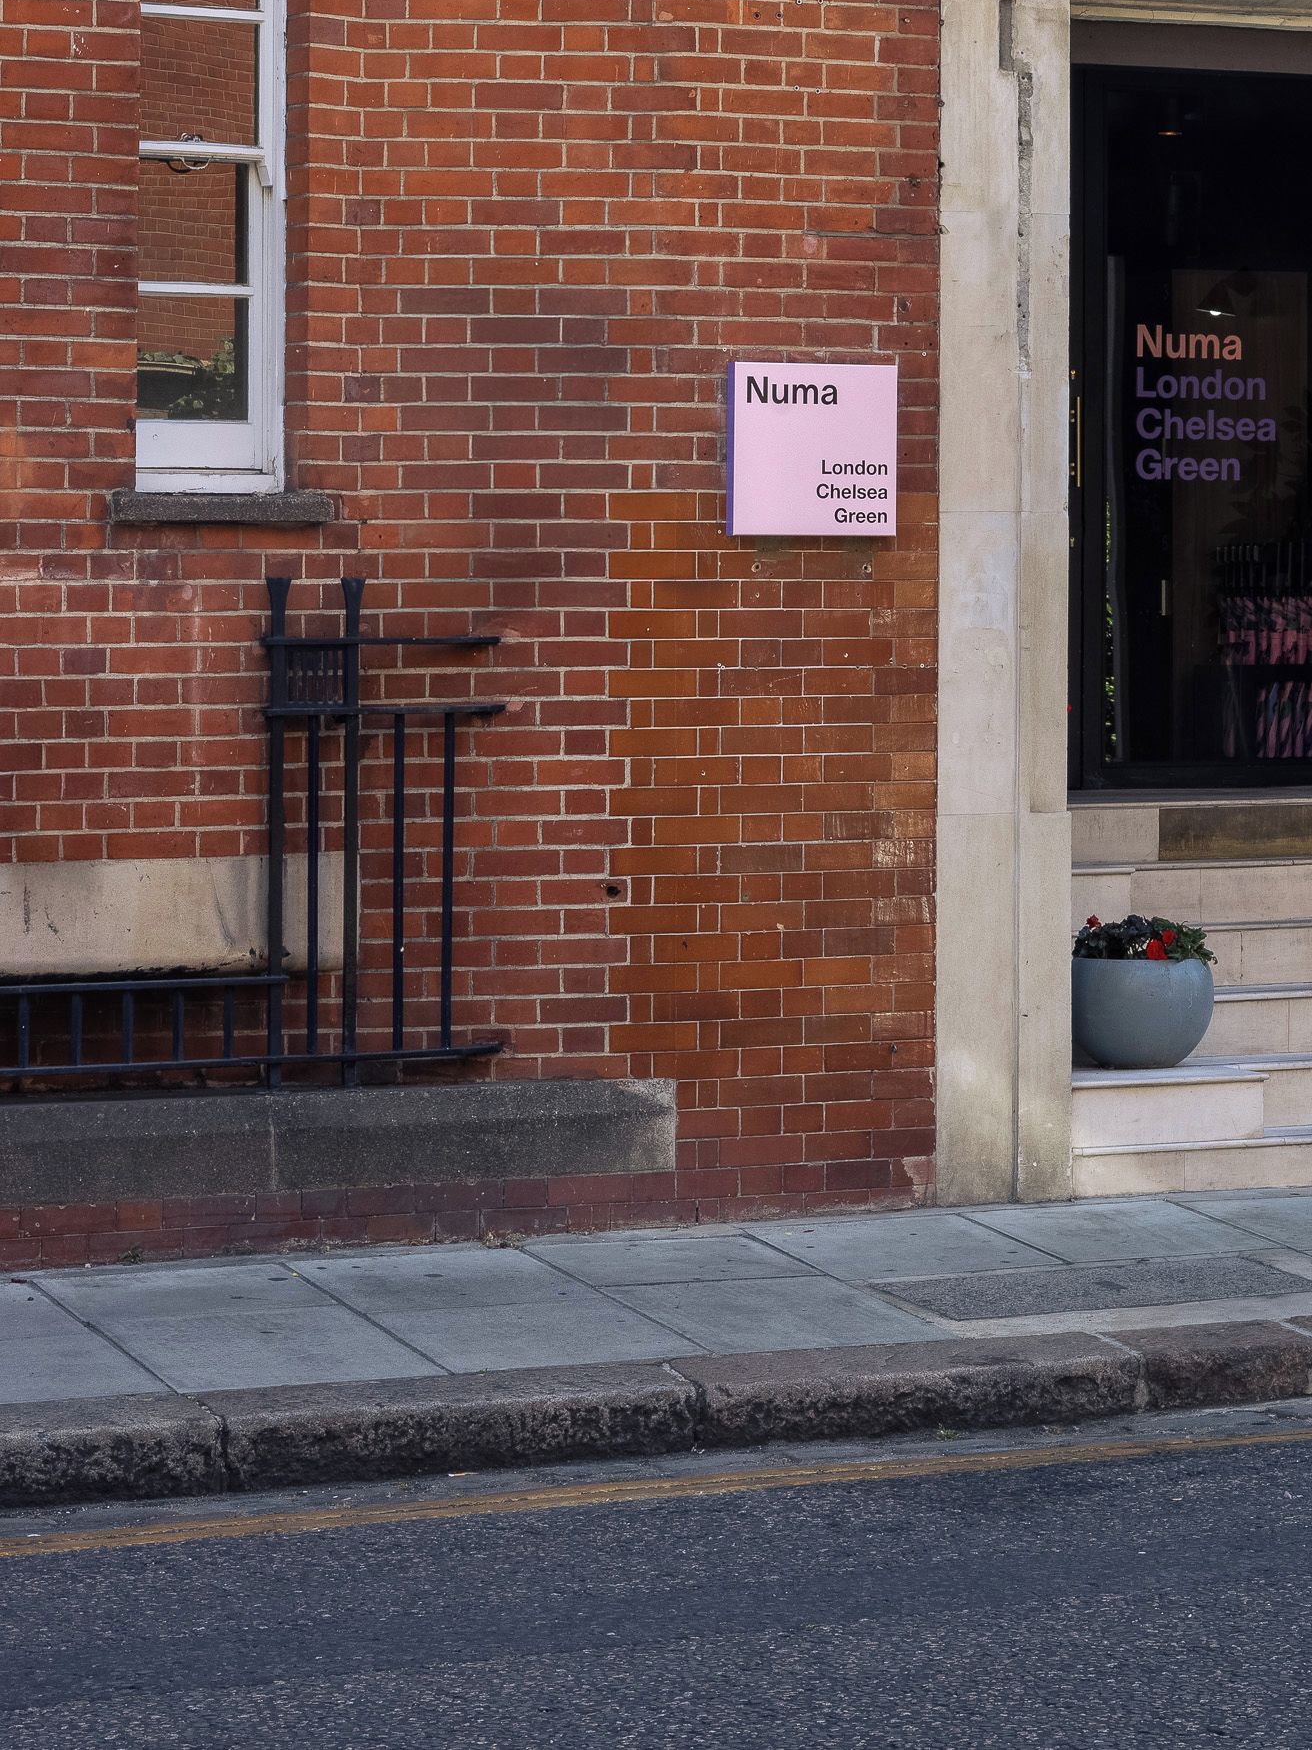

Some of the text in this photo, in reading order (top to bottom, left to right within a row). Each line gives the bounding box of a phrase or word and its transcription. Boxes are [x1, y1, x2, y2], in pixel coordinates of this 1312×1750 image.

[1136, 323, 1243, 361] Numa
[746, 375, 838, 405] Numa
[1135, 366, 1267, 401] London
[1135, 407, 1277, 443] Chelsea
[821, 459, 888, 475] London
[1135, 448, 1241, 482] Green
[816, 483, 888, 499] Chelsea
[834, 507, 888, 524] Green
